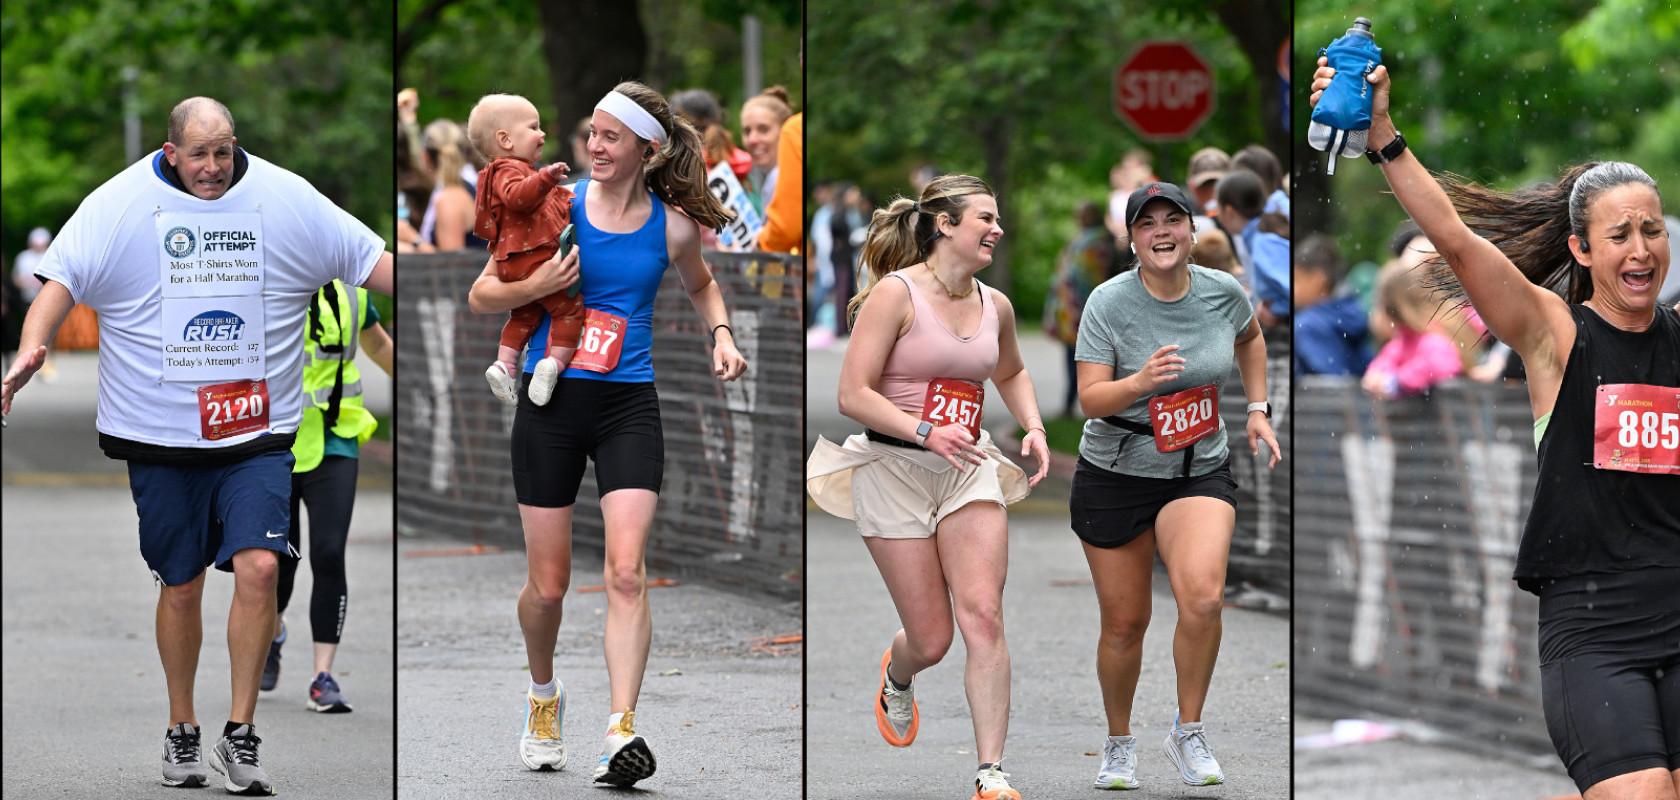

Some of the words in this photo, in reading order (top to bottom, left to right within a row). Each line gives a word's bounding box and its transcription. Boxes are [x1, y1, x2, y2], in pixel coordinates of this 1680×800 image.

[1121, 71, 1209, 109] STOP
[204, 231, 256, 241] OFFICIAL
[204, 242, 256, 252] ATTEMPT
[170, 261, 193, 270] Most
[196, 259, 233, 268] T-Shirts
[235, 259, 258, 268] Worn
[170, 274, 184, 284] for
[195, 273, 213, 282] Half
[216, 272, 259, 282] Marathon
[194, 318, 214, 326] RECORD
[215, 316, 239, 325] BREAKER
[185, 323, 245, 342] RUSH
[165, 344, 202, 353] Current
[205, 342, 239, 352] Record:
[248, 343, 259, 353] 127
[166, 357, 202, 368] Today's
[205, 357, 244, 367] Attempt:
[1617, 399, 1653, 407] MARATHON
[207, 395, 263, 426] 2120
[929, 394, 980, 427] 2457
[1158, 398, 1213, 436] 2820
[1618, 410, 1679, 449] 885
